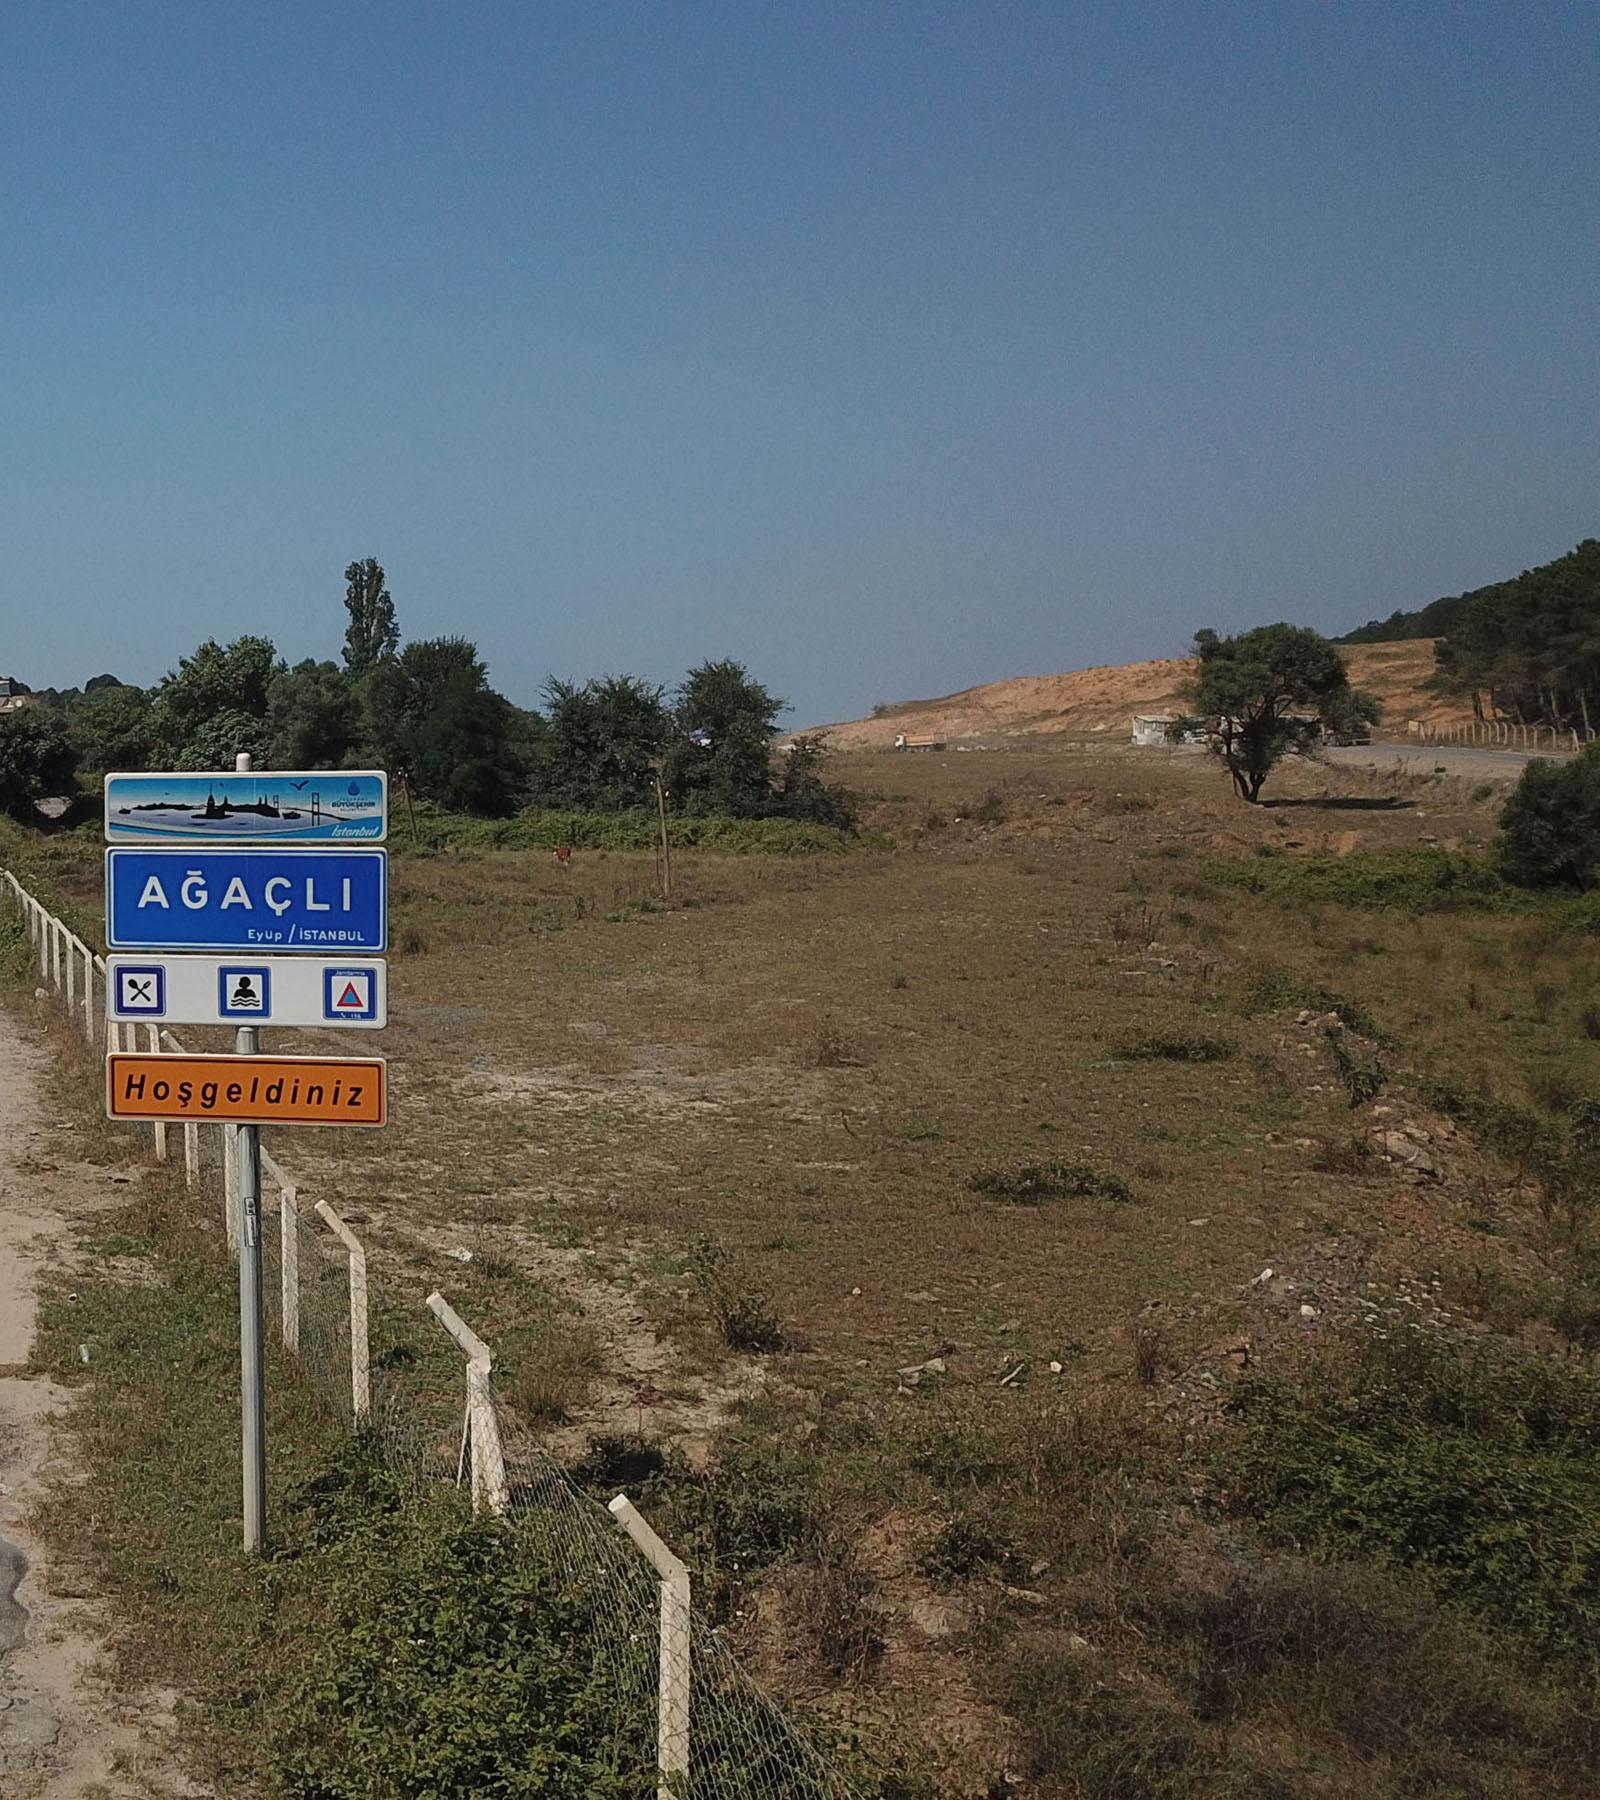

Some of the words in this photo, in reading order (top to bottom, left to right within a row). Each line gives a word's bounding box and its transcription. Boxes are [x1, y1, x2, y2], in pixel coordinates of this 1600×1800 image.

[137, 870, 351, 917] AĞAÇLI
[299, 927, 366, 942] İSTANBUL
[124, 1073, 364, 1109] Hoşgeldiniz
